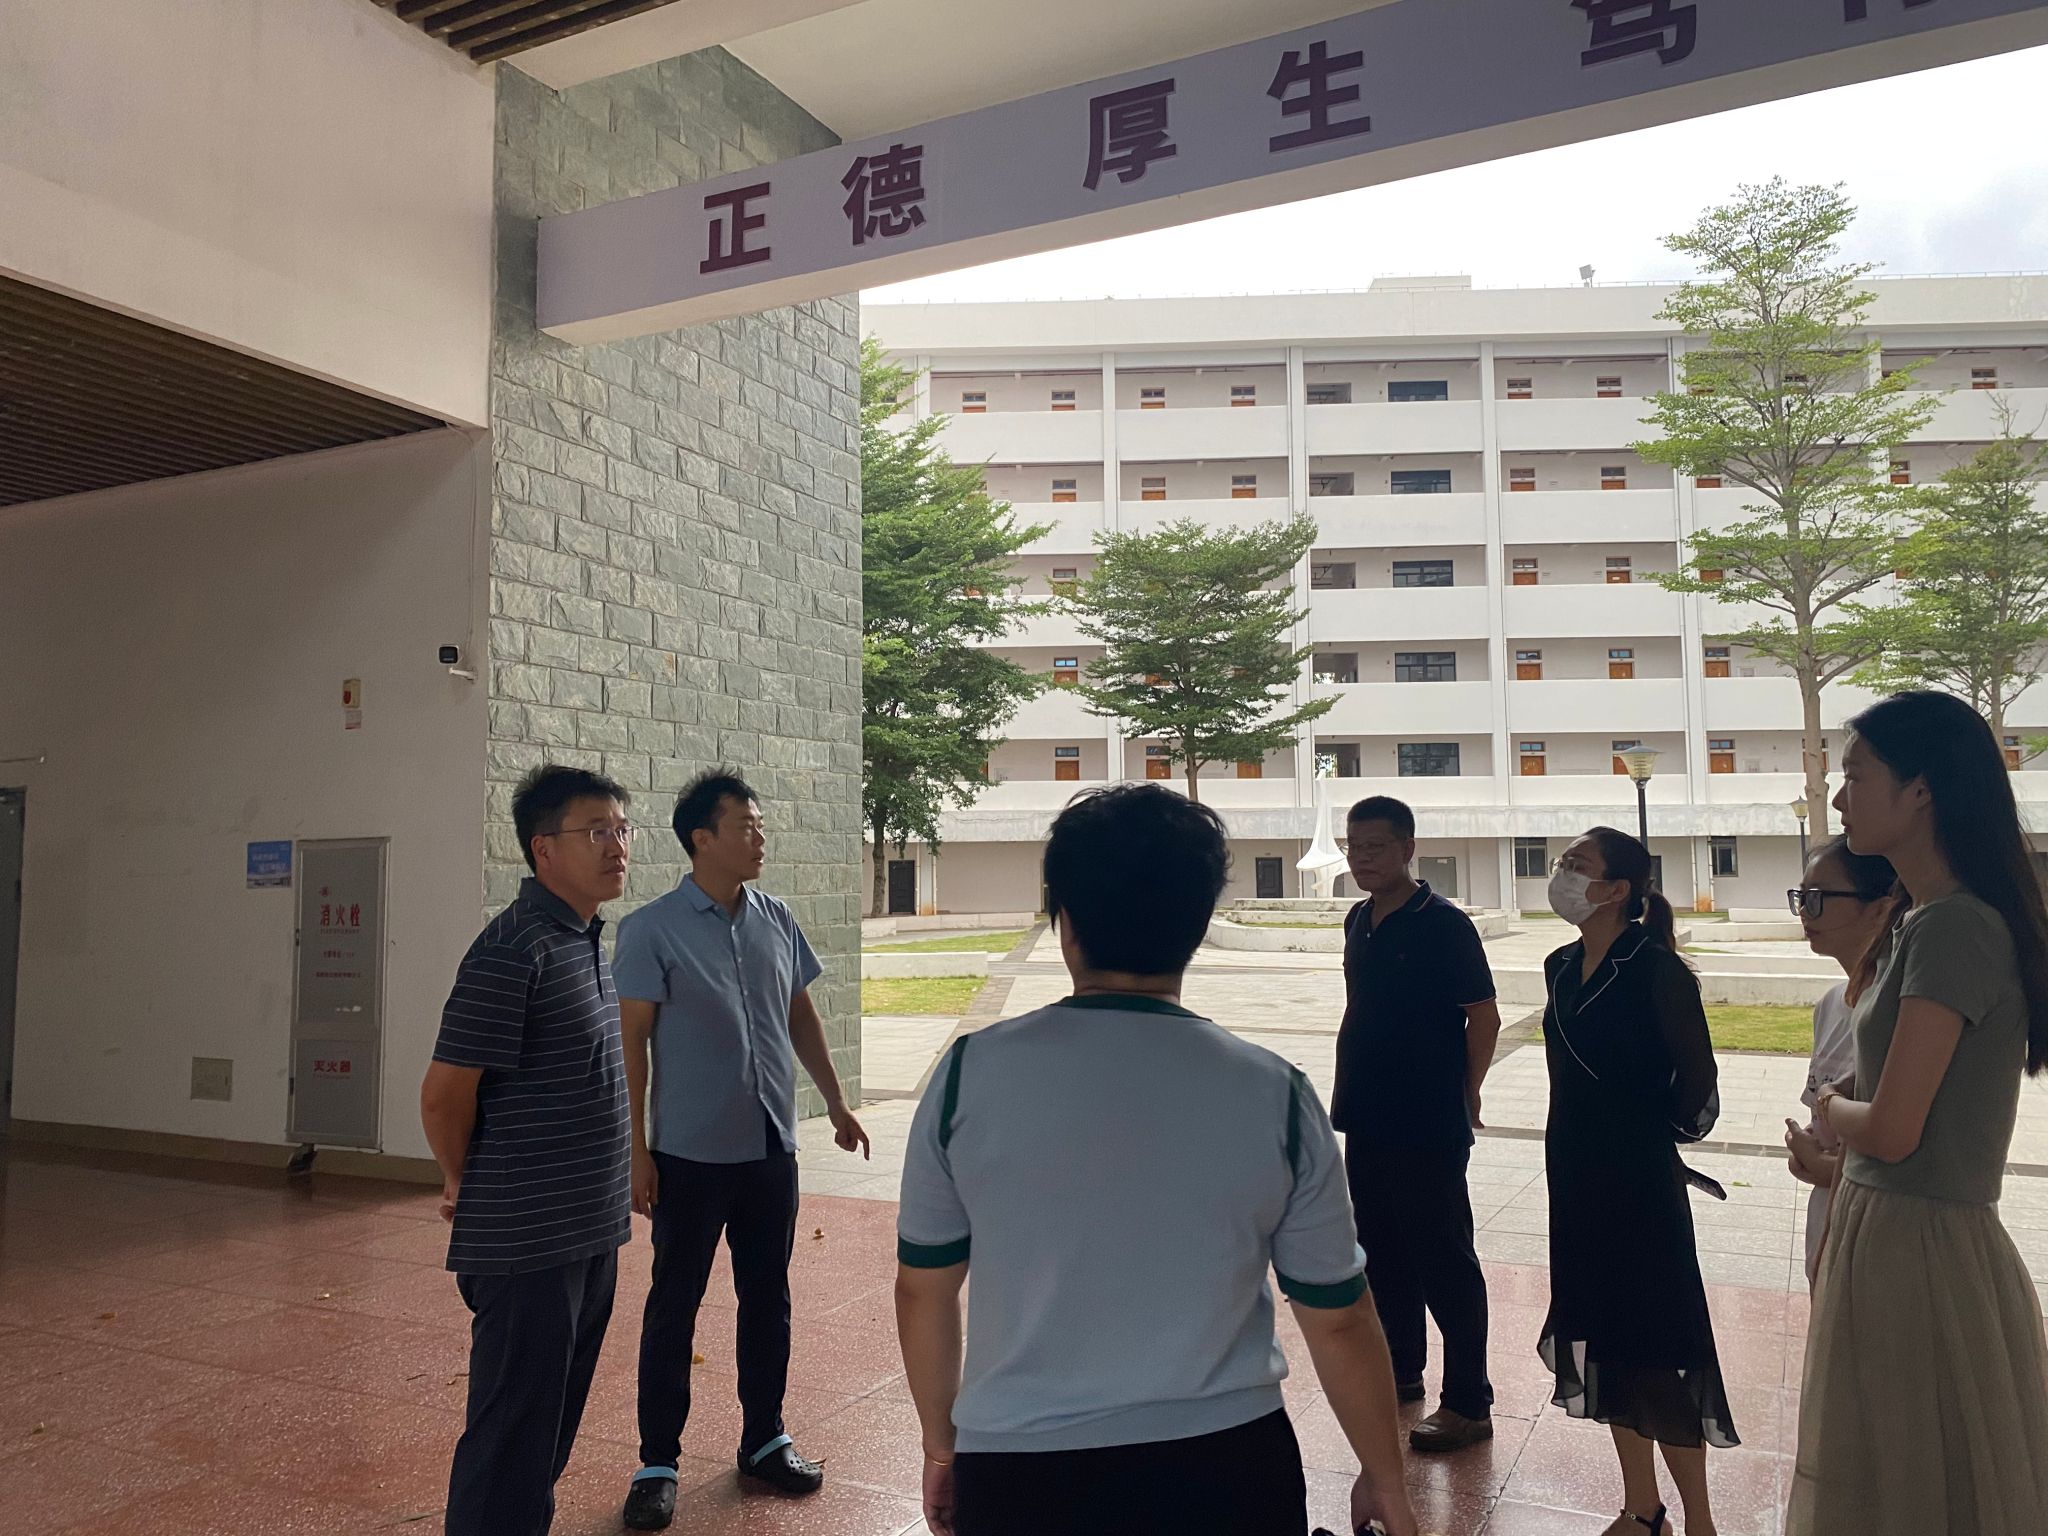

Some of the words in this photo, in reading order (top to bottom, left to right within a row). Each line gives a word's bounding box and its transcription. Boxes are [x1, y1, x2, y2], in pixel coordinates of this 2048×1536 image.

[700, 143, 926, 275] 正德
[1083, 39, 1371, 191] 厚生
[320, 903, 360, 928] 消火栓
[313, 1060, 352, 1074] 灭火器
